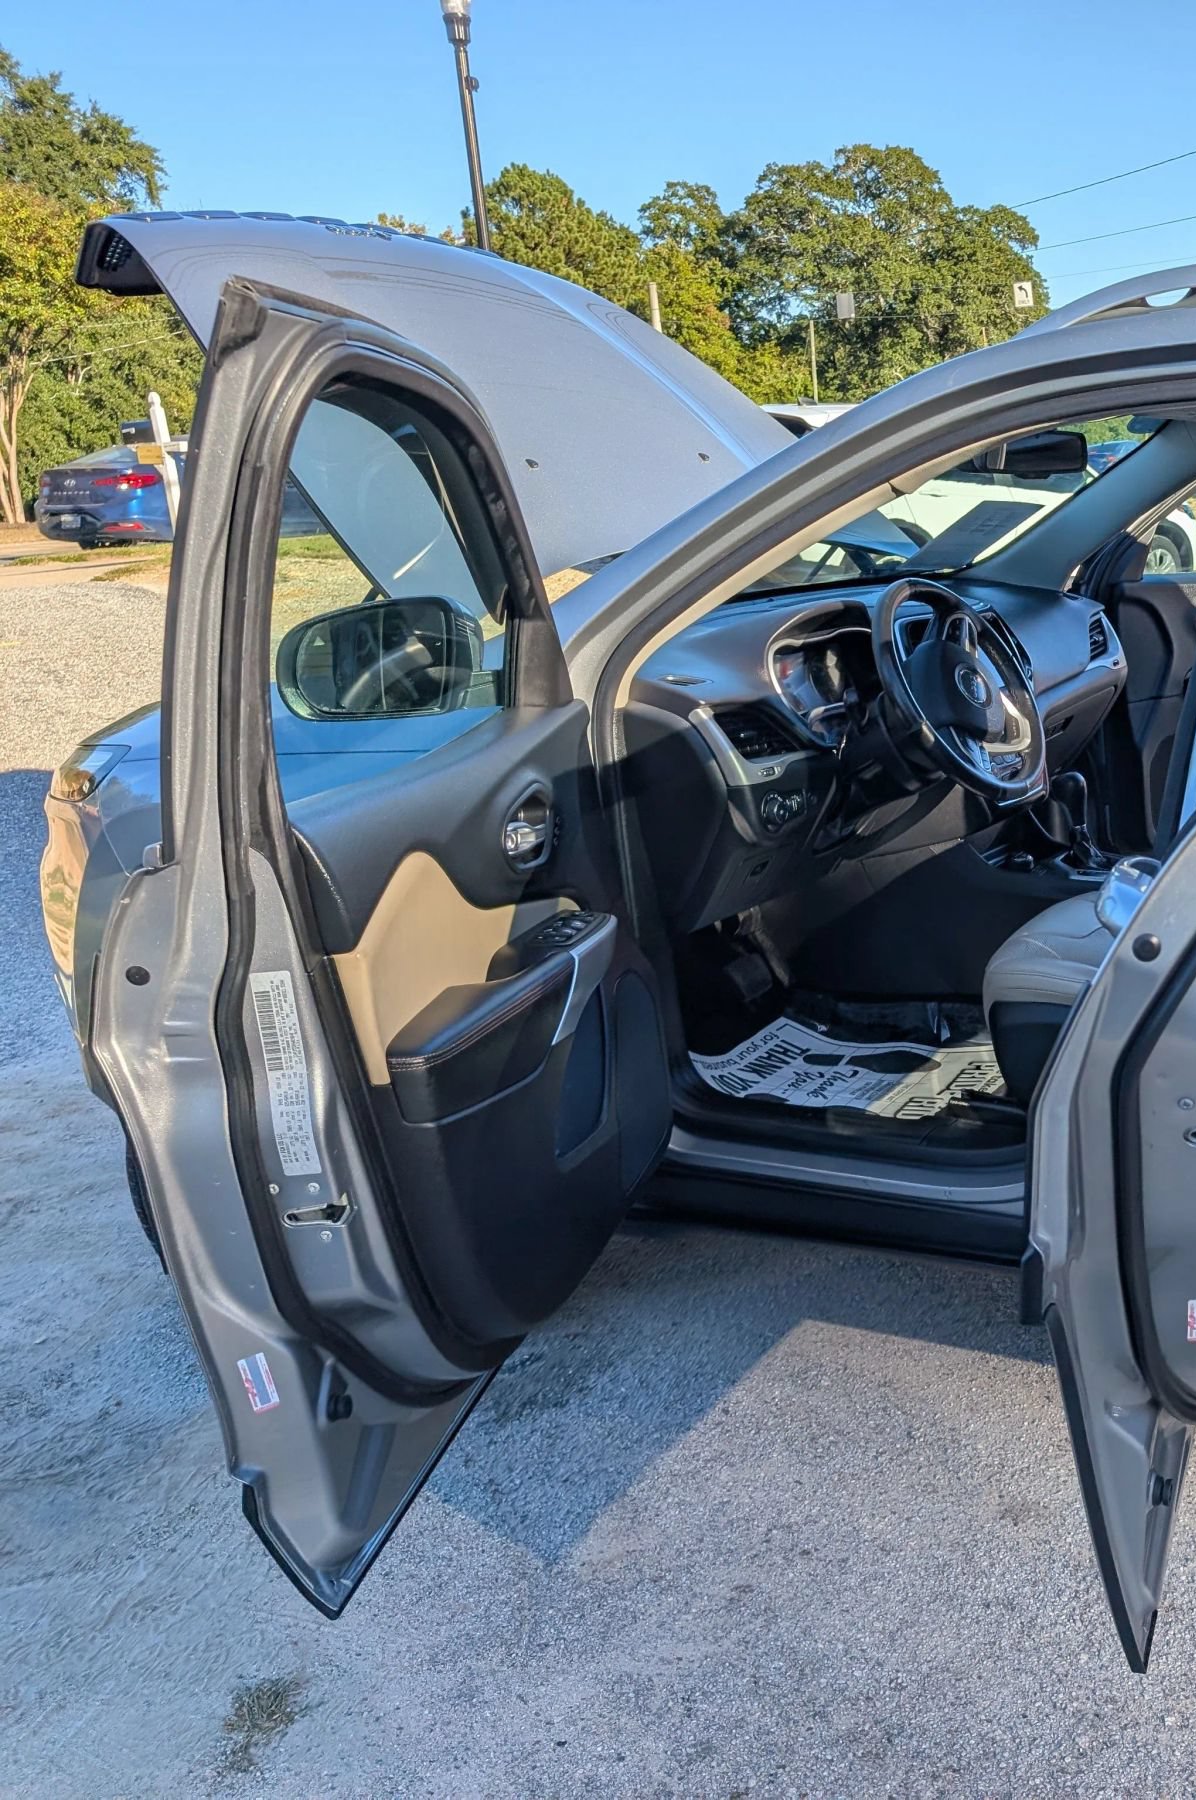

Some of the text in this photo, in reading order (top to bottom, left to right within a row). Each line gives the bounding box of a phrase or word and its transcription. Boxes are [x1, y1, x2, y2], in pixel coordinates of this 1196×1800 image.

[763, 1031, 781, 1046] for
[738, 1041, 764, 1061] your
[710, 1039, 811, 1096] THANK YOU
[806, 1069, 860, 1100] Thank
[894, 1096, 945, 1120] RID
